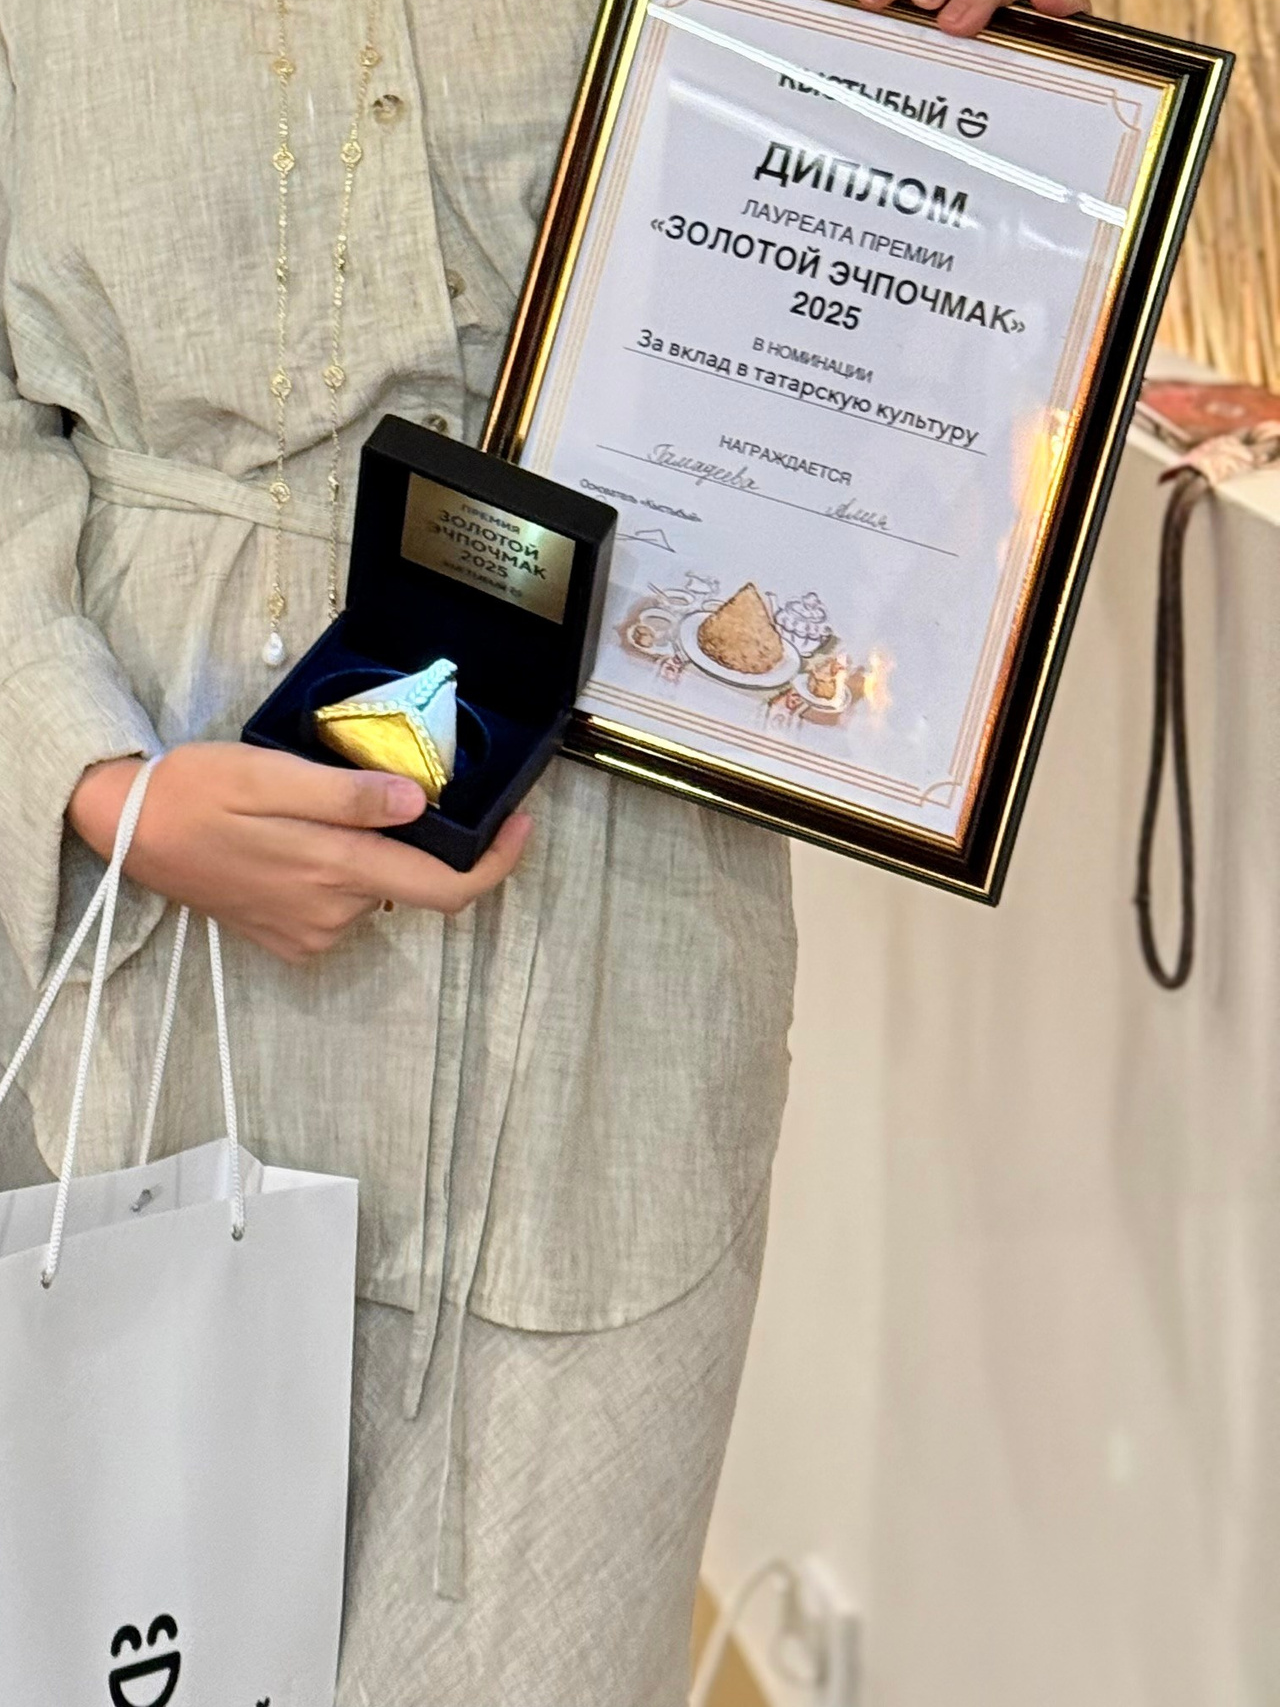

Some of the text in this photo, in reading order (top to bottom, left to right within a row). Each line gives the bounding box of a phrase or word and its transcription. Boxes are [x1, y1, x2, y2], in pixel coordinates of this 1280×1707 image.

[753, 141, 969, 228] ДИПЛОМ
[741, 199, 956, 273] ЛАУРЕАТА ПРЕМИИ
[649, 214, 1026, 335] «ЗОЛОТОЙ ЭЧПОЧМАК»
[789, 290, 863, 331] 2025
[752, 337, 874, 384] В НОМИНАЦИИ
[636, 329, 980, 448] За вклад в татарскую культуру
[718, 434, 853, 487] НАГРАЖДАЕТСЯ
[439, 509, 539, 560] ЗОЛОТОЙ
[461, 503, 521, 535] ПРЕМИЯ
[429, 522, 547, 580] ЭЧПОЧМАК
[459, 550, 509, 578] 2025
